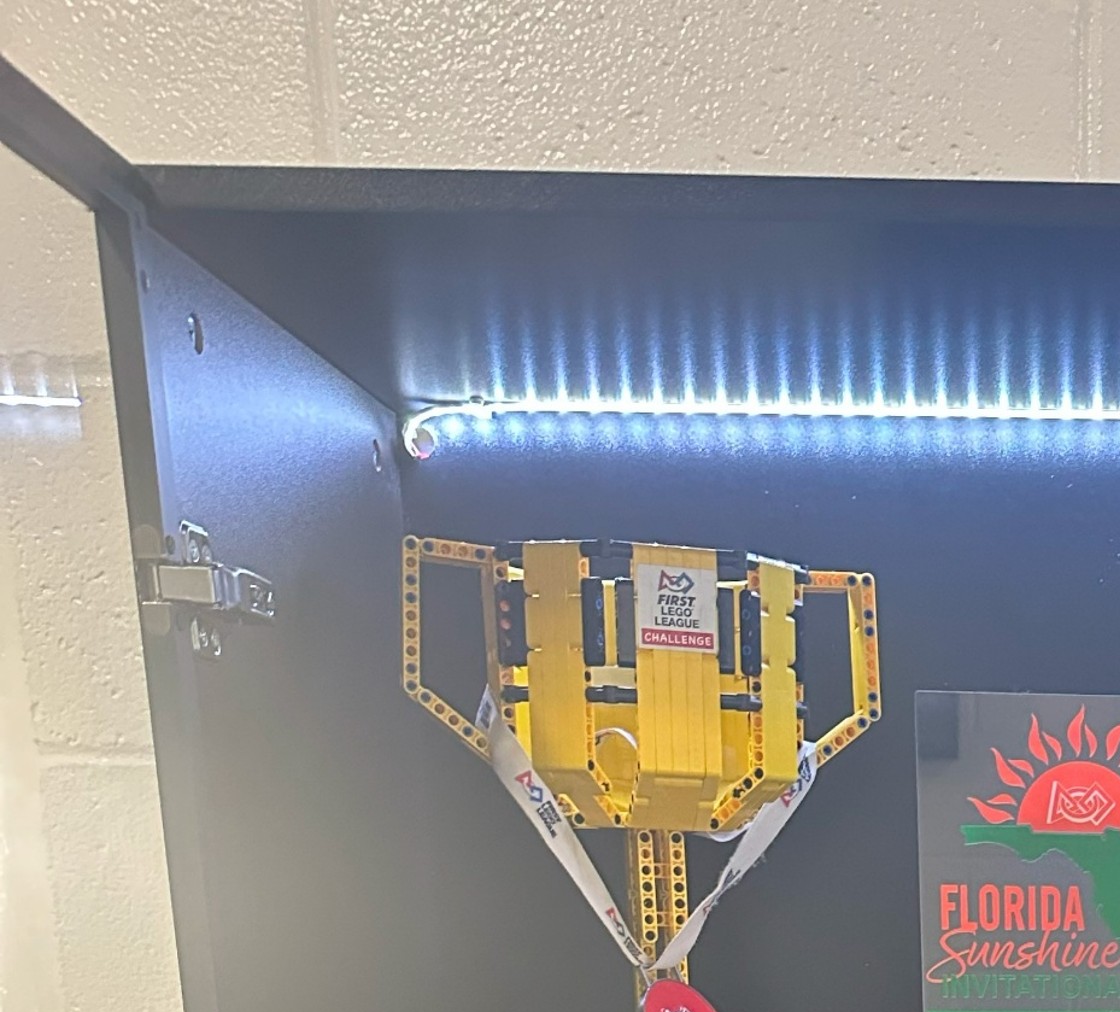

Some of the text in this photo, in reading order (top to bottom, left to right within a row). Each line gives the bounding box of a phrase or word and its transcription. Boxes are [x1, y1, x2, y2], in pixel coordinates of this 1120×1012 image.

[657, 594, 696, 607] FIRST
[661, 606, 692, 617] LEGO
[655, 616, 700, 628] LEAGUE
[644, 632, 712, 646] CHALLENGE
[940, 884, 1085, 931] FLORIDA
